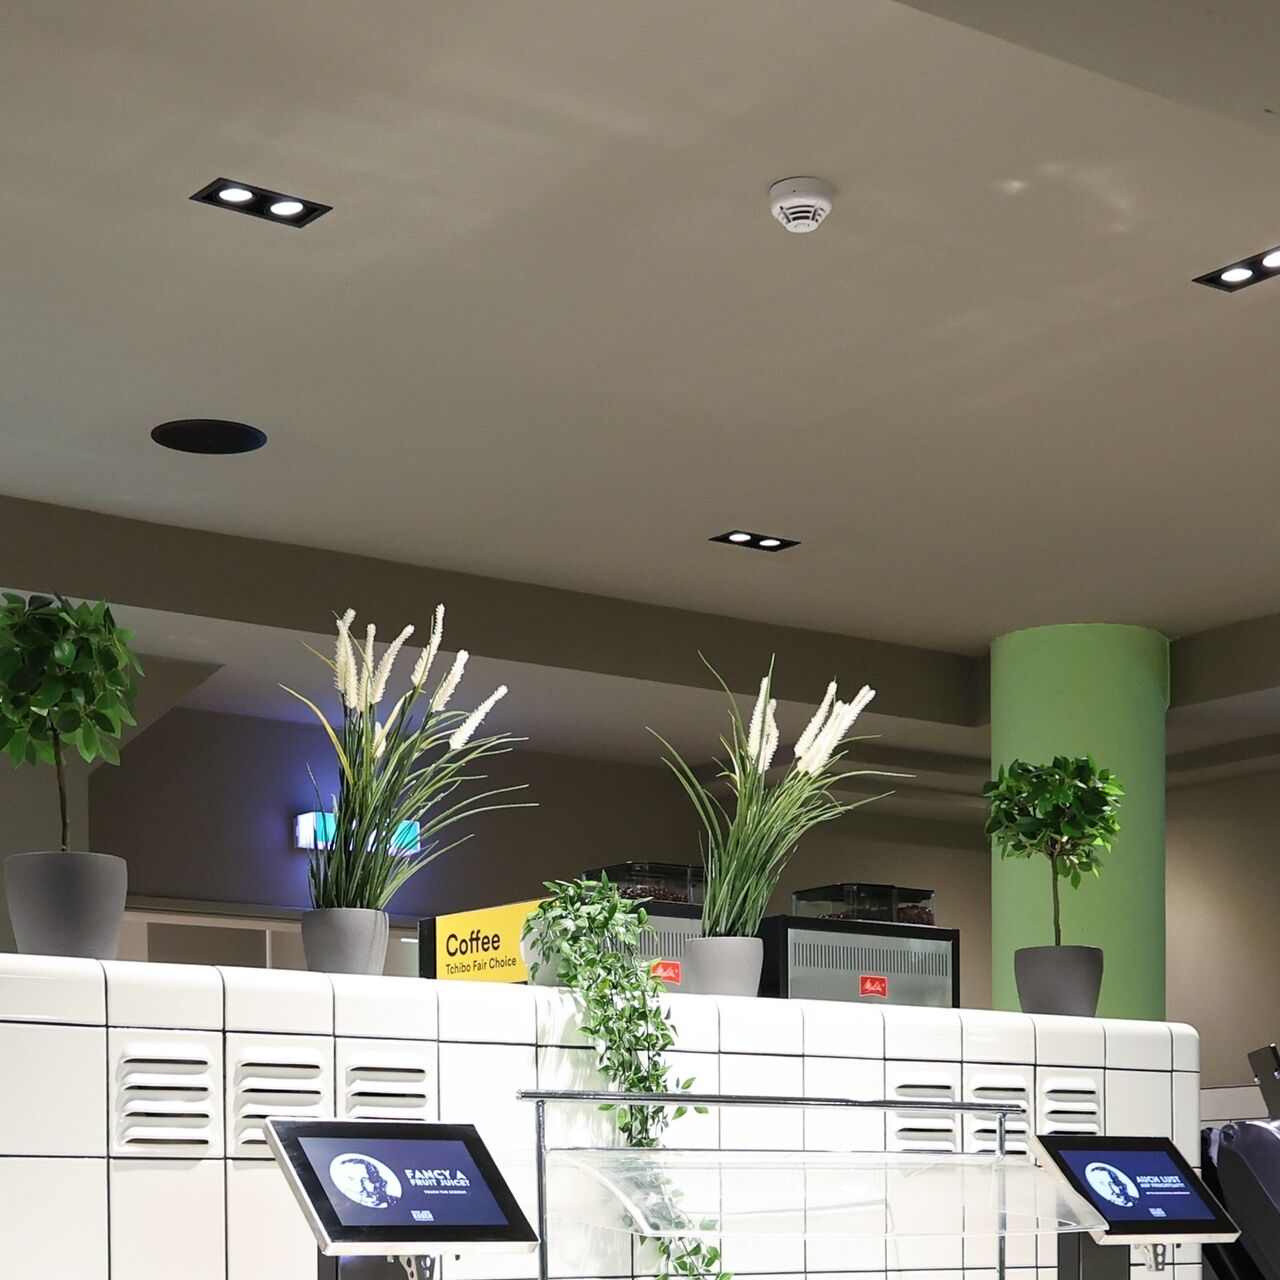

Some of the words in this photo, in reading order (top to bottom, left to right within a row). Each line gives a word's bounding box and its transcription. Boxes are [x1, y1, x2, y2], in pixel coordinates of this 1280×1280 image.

[446, 929, 501, 957] Coffee
[446, 961, 472, 975] Tchibo
[473, 958, 488, 971] Fair
[489, 955, 517, 969] Choice
[404, 1169, 451, 1179] FANCY
[456, 1169, 467, 1180] A
[1136, 1175, 1160, 1183] AUCH
[1160, 1175, 1181, 1183] LUST
